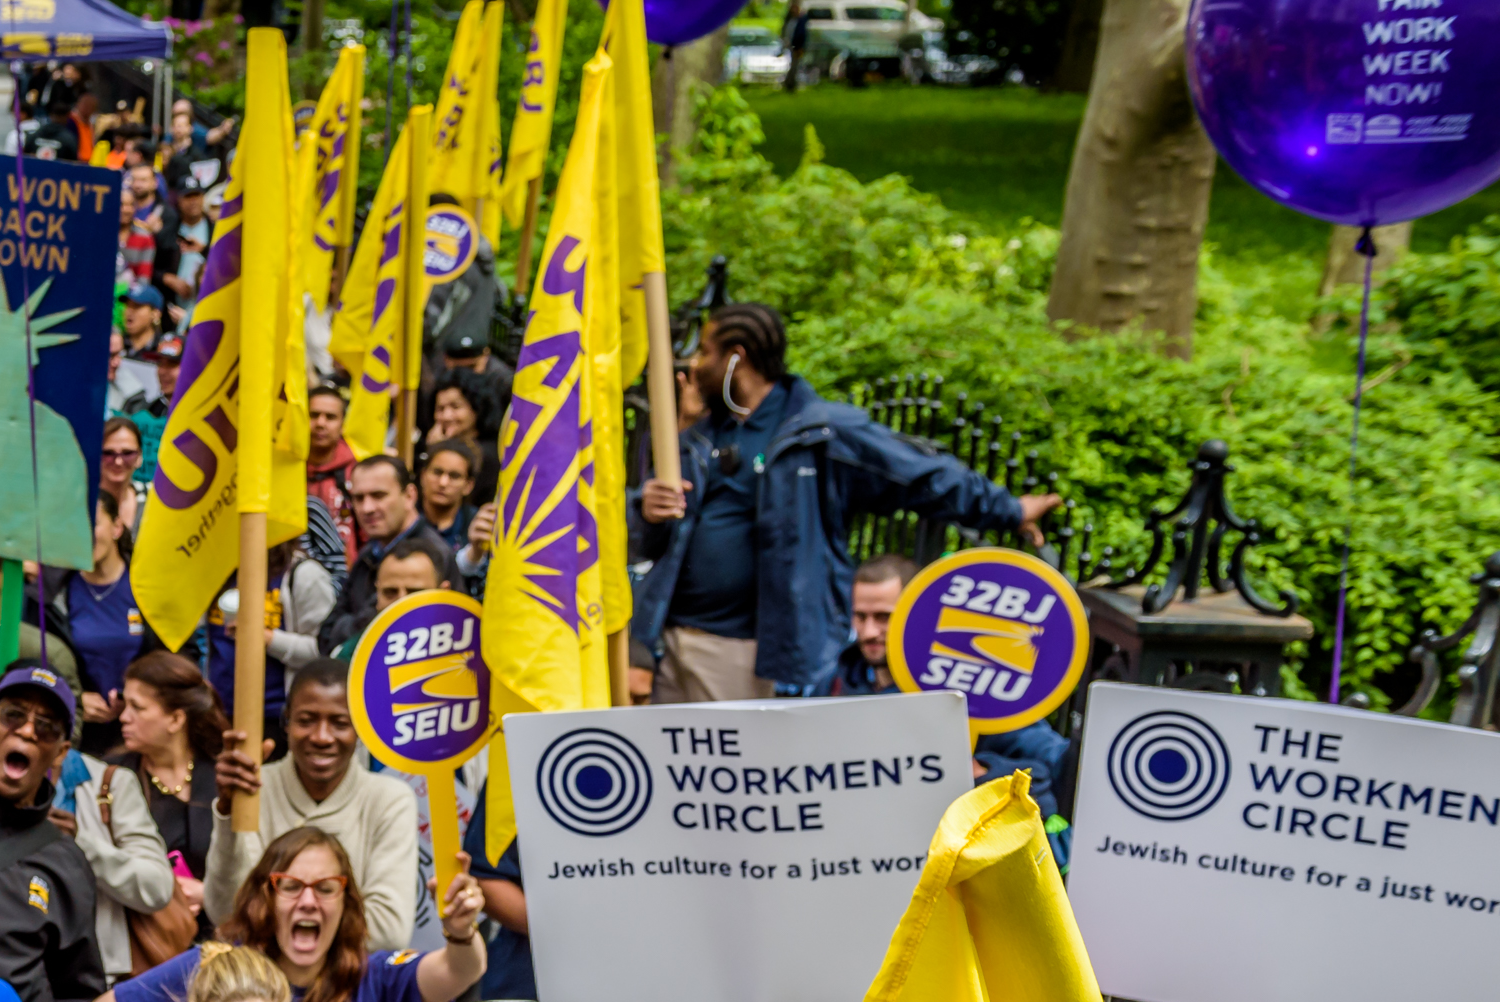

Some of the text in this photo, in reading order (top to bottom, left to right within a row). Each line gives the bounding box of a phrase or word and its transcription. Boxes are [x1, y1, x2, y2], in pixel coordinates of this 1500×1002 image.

[1362, 16, 1458, 45] WORK
[1362, 49, 1452, 76] WEEK
[1365, 82, 1443, 106] NOW!
[8, 173, 111, 214] WON'T
[940, 574, 1057, 623] 32BJ
[384, 617, 474, 665] 32BJ
[919, 656, 1032, 702] SEIU
[392, 699, 480, 746] SEIU
[662, 727, 741, 757] THE
[1253, 723, 1343, 763] THE
[666, 754, 945, 796] WORKMEN'S
[1250, 761, 1500, 827] WORKMEN
[673, 802, 824, 834] CIRCLE
[1242, 801, 1411, 851] CIRCLE
[548, 851, 930, 881] Jewish culture for a just wor
[1097, 835, 1500, 916] Jewish culture for a just wor
